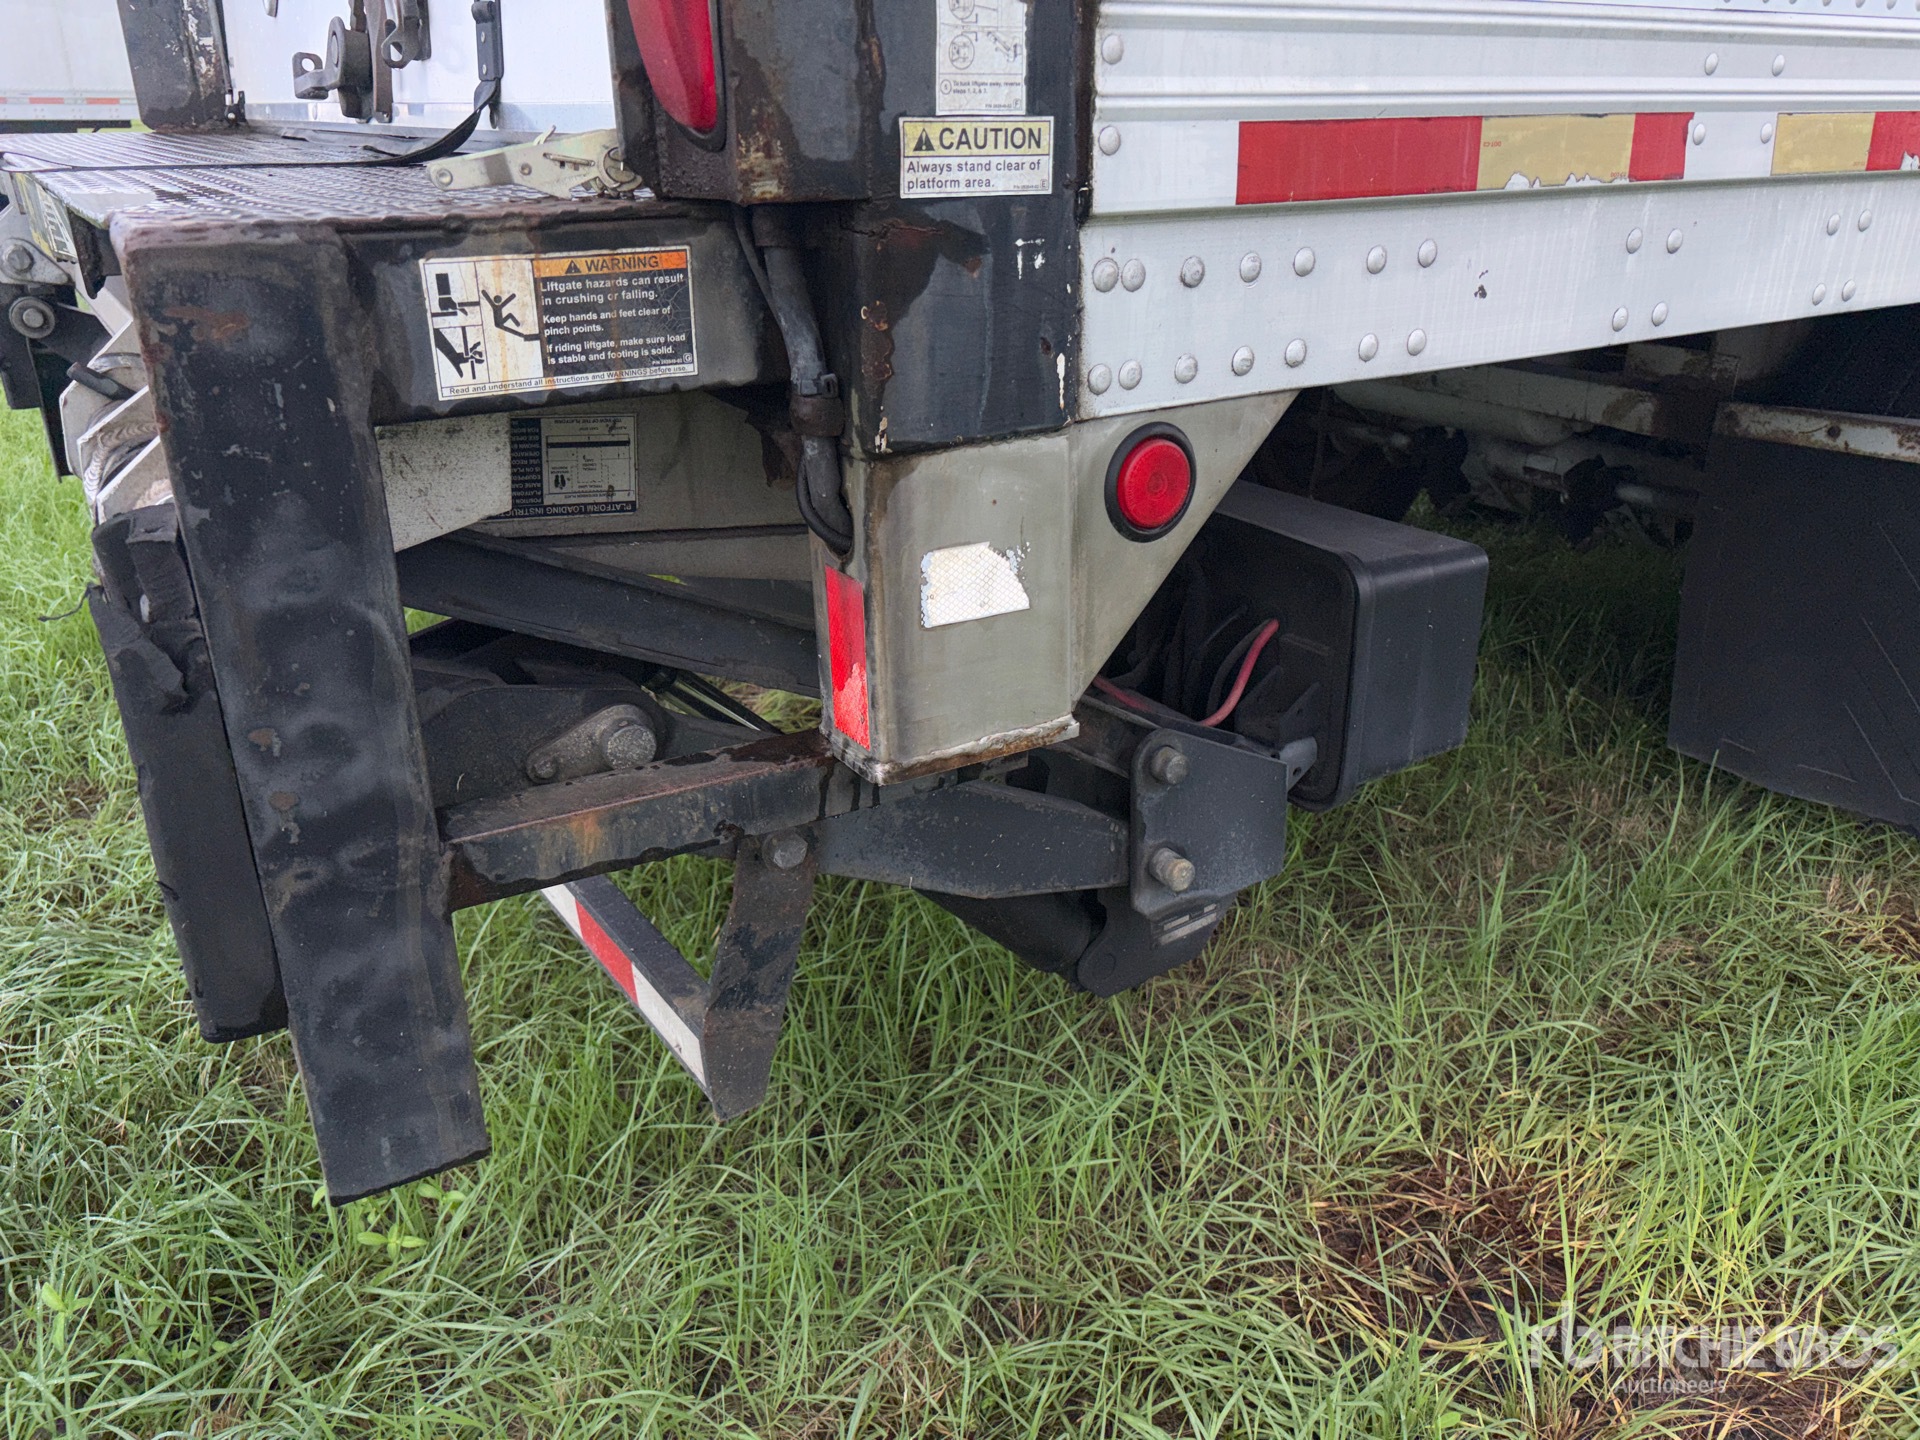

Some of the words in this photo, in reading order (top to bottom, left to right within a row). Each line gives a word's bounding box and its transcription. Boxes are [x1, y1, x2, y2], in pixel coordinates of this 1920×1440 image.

[939, 127, 1042, 151] CAUTION
[907, 160, 953, 175] Always
[957, 160, 991, 172] stand
[995, 159, 1026, 171] clear
[1029, 158, 1041, 171] of
[907, 177, 960, 192] platform
[964, 178, 995, 188] area.
[1041, 180, 1047, 188] E
[584, 255, 660, 273] WARNING
[540, 279, 583, 293] Liftgate
[586, 275, 629, 289] hazards
[632, 276, 650, 286] can
[653, 273, 684, 284] result
[541, 295, 552, 306] in
[555, 291, 604, 305] crushing
[607, 292, 619, 301] or
[621, 289, 658, 301] falling.
[542, 314, 567, 325] Keep
[569, 311, 598, 322] hands
[600, 310, 617, 320] and
[619, 309, 637, 319] feet
[638, 307, 660, 317] clear
[661, 305, 671, 315] of
[543, 325, 571, 337] pinch
[572, 324, 604, 336] points.
[546, 344, 553, 354] If
[555, 342, 582, 355] riding
[584, 339, 618, 351] liftgate,
[620, 336, 644, 347] make
[645, 335, 666, 345] sure
[666, 333, 686, 343] load
[547, 356, 556, 365] is
[558, 353, 586, 364] stable
[588, 351, 606, 361] and
[607, 348, 639, 361] footing
[641, 347, 649, 357] is
[651, 345, 675, 356] solid.
[684, 354, 691, 362] G
[449, 385, 470, 395] Read
[472, 384, 487, 393] and
[488, 380, 533, 391] understand
[534, 378, 543, 387] all
[545, 374, 590, 386] instructions
[591, 371, 605, 380] and
[606, 368, 648, 379] WARNINGS
[649, 366, 672, 375] before
[673, 365, 688, 373] use.
[545, 504, 585, 515] LOADING
[587, 503, 632, 513] PLATFORM
